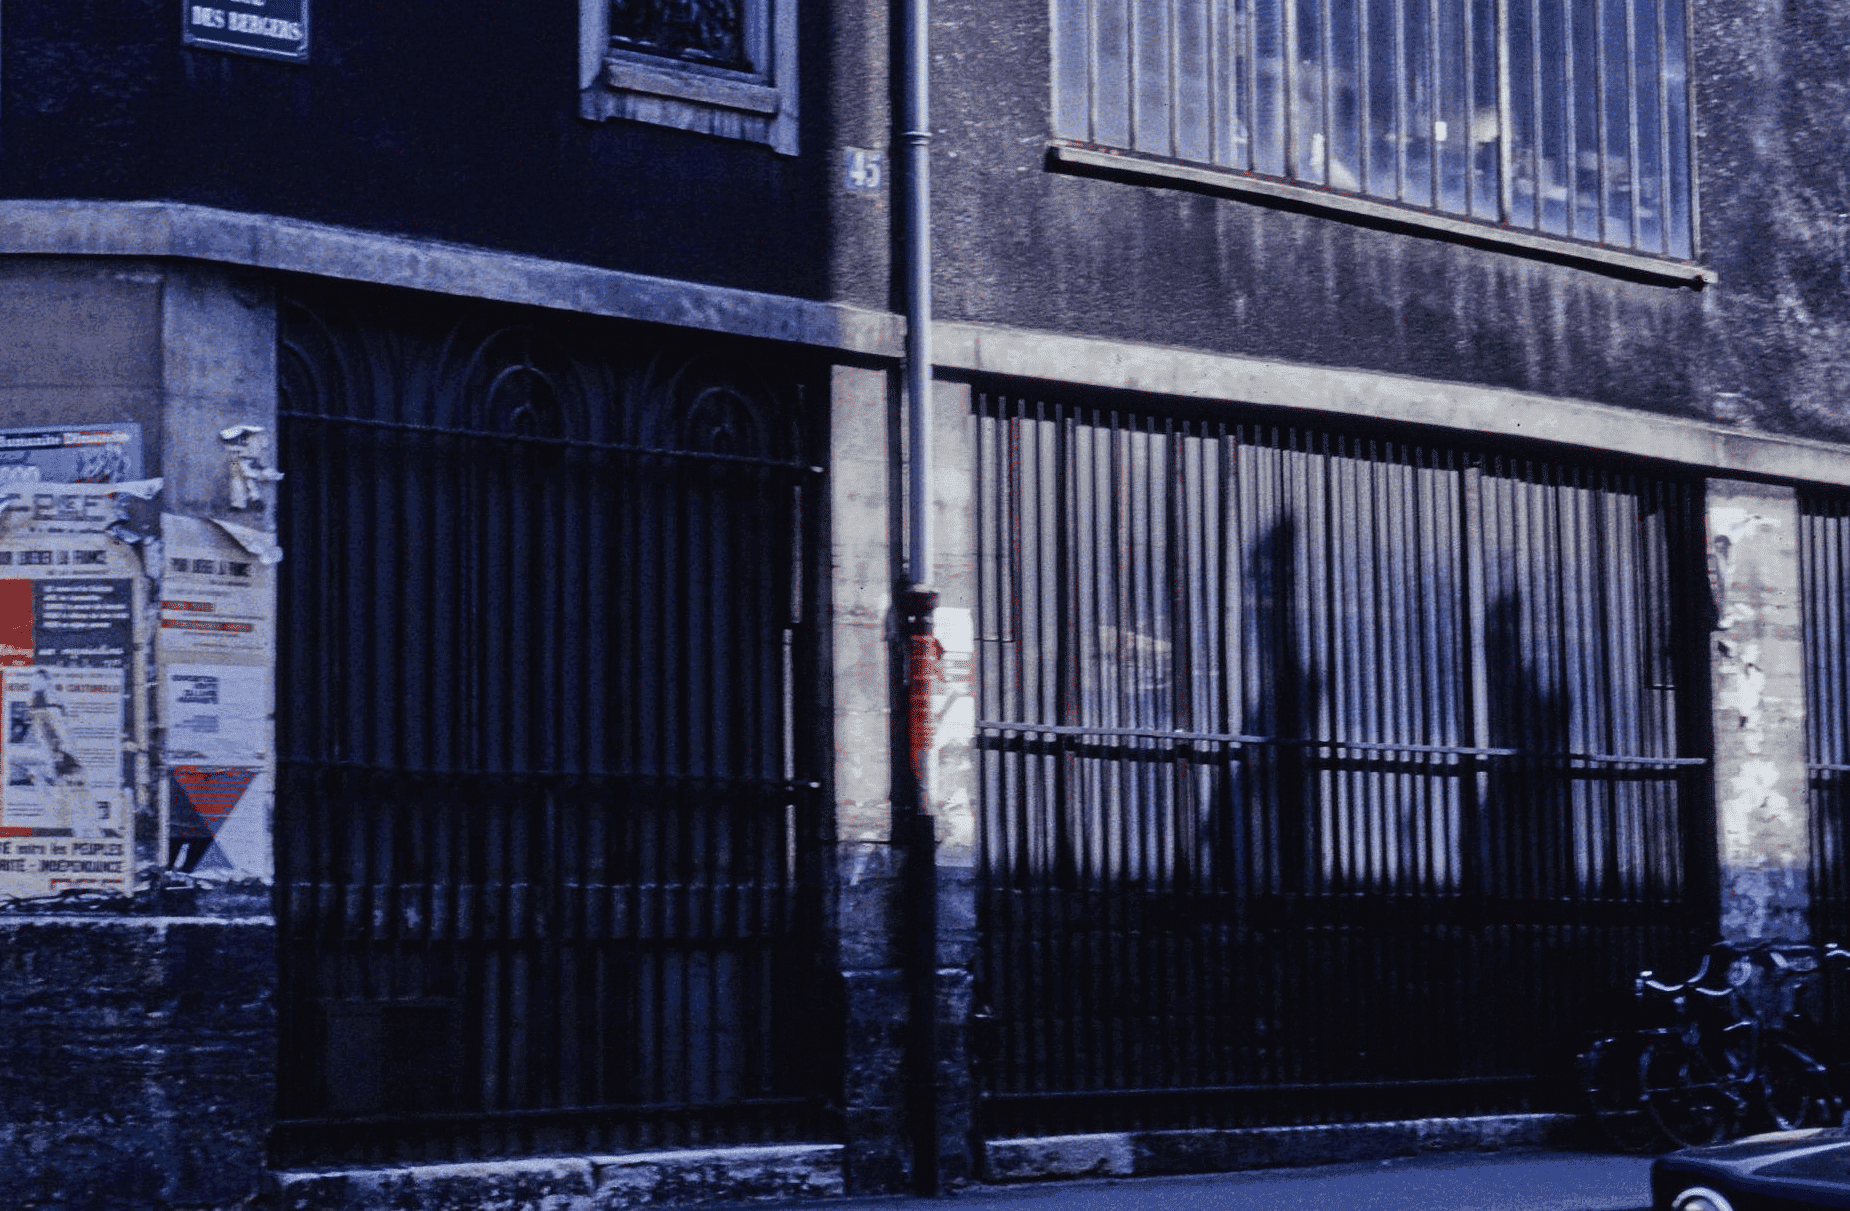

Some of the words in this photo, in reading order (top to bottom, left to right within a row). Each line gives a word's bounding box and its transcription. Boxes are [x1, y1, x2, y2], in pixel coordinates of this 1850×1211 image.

[191, 5, 225, 29] DES
[849, 151, 881, 188] 45
[49, 841, 67, 855] les
[71, 842, 124, 856] PEUPLES
